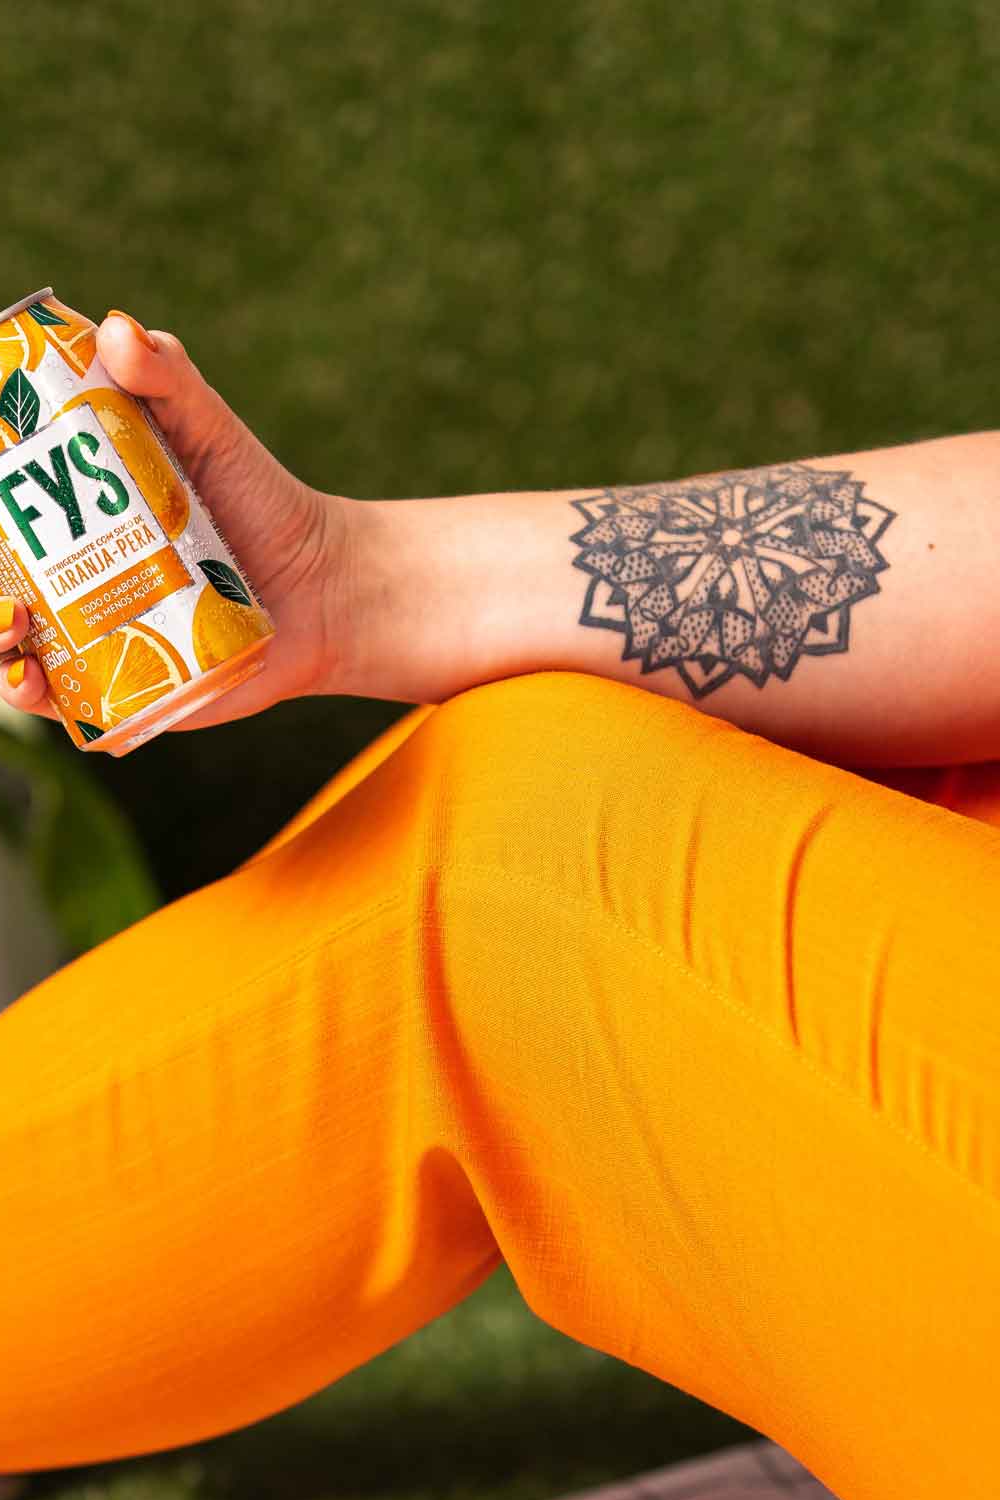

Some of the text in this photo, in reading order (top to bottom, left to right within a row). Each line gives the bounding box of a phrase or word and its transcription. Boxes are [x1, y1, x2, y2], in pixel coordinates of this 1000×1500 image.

[44, 513, 145, 577] REFRIGERANTE COM SUCO DE
[49, 524, 157, 598] LARANJA-PERA
[80, 563, 160, 616] TODO O SABOR COM
[84, 613, 104, 628] 50%
[103, 597, 132, 617] MENOS
[42, 644, 72, 672] 350ml
